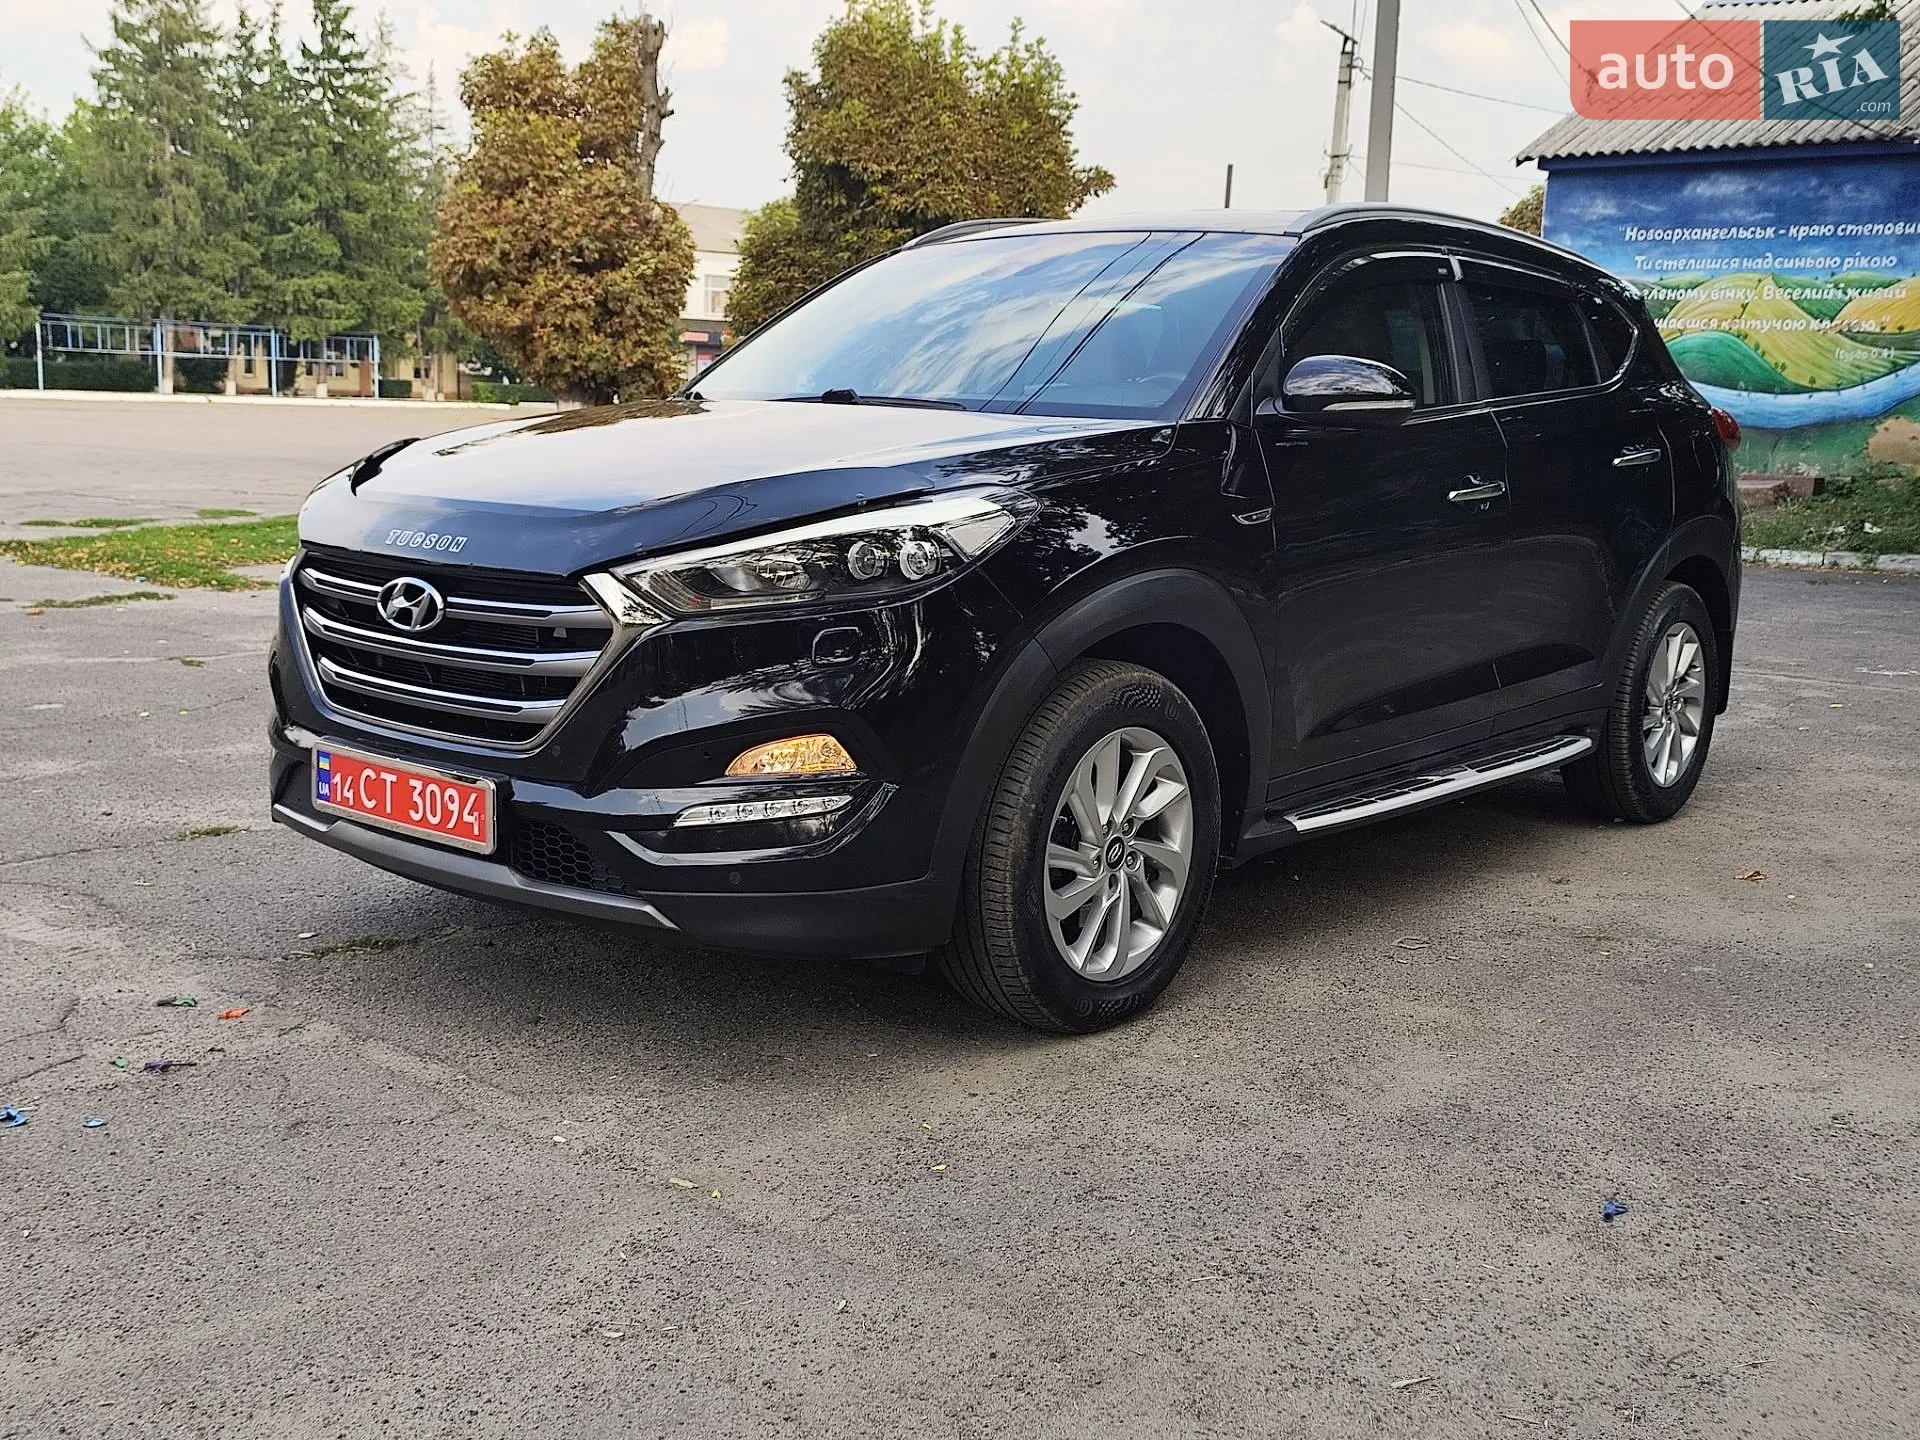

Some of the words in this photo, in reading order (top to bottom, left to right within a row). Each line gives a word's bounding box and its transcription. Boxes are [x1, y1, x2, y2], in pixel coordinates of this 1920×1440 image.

[1788, 224, 1834, 241] краю
[1634, 255, 1653, 270] Ти
[1654, 257, 1739, 271] стелишся
[1742, 252, 1773, 269] над
[1775, 255, 1841, 269] синьою
[1843, 251, 1898, 271] рікою
[1763, 283, 1835, 300] Веселий
[384, 528, 468, 553] TUCSON
[318, 781, 330, 797] UA
[408, 778, 480, 836] 3094
